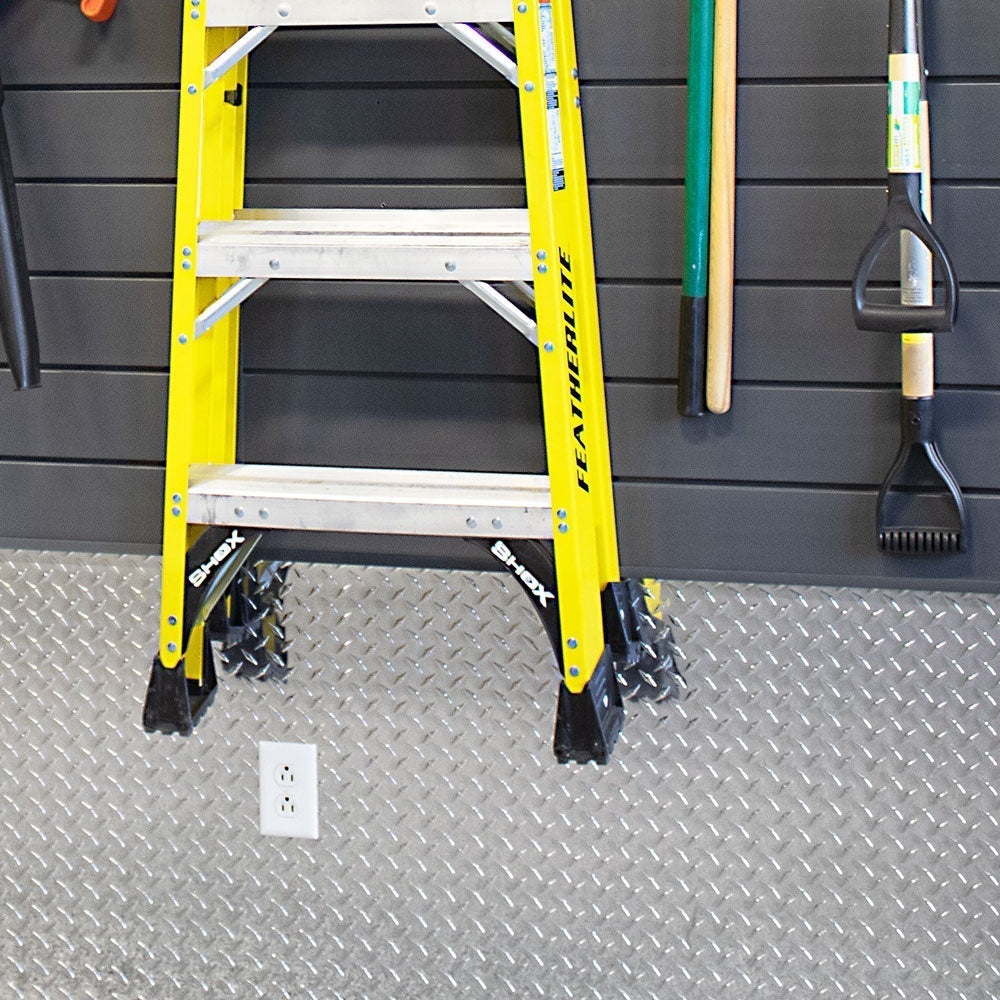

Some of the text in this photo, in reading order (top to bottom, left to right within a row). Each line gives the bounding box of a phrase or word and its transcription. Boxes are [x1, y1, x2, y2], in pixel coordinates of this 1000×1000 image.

[558, 246, 589, 494] FEATHERLITE
[188, 529, 246, 588] SHOX
[490, 540, 555, 608] SHOX
